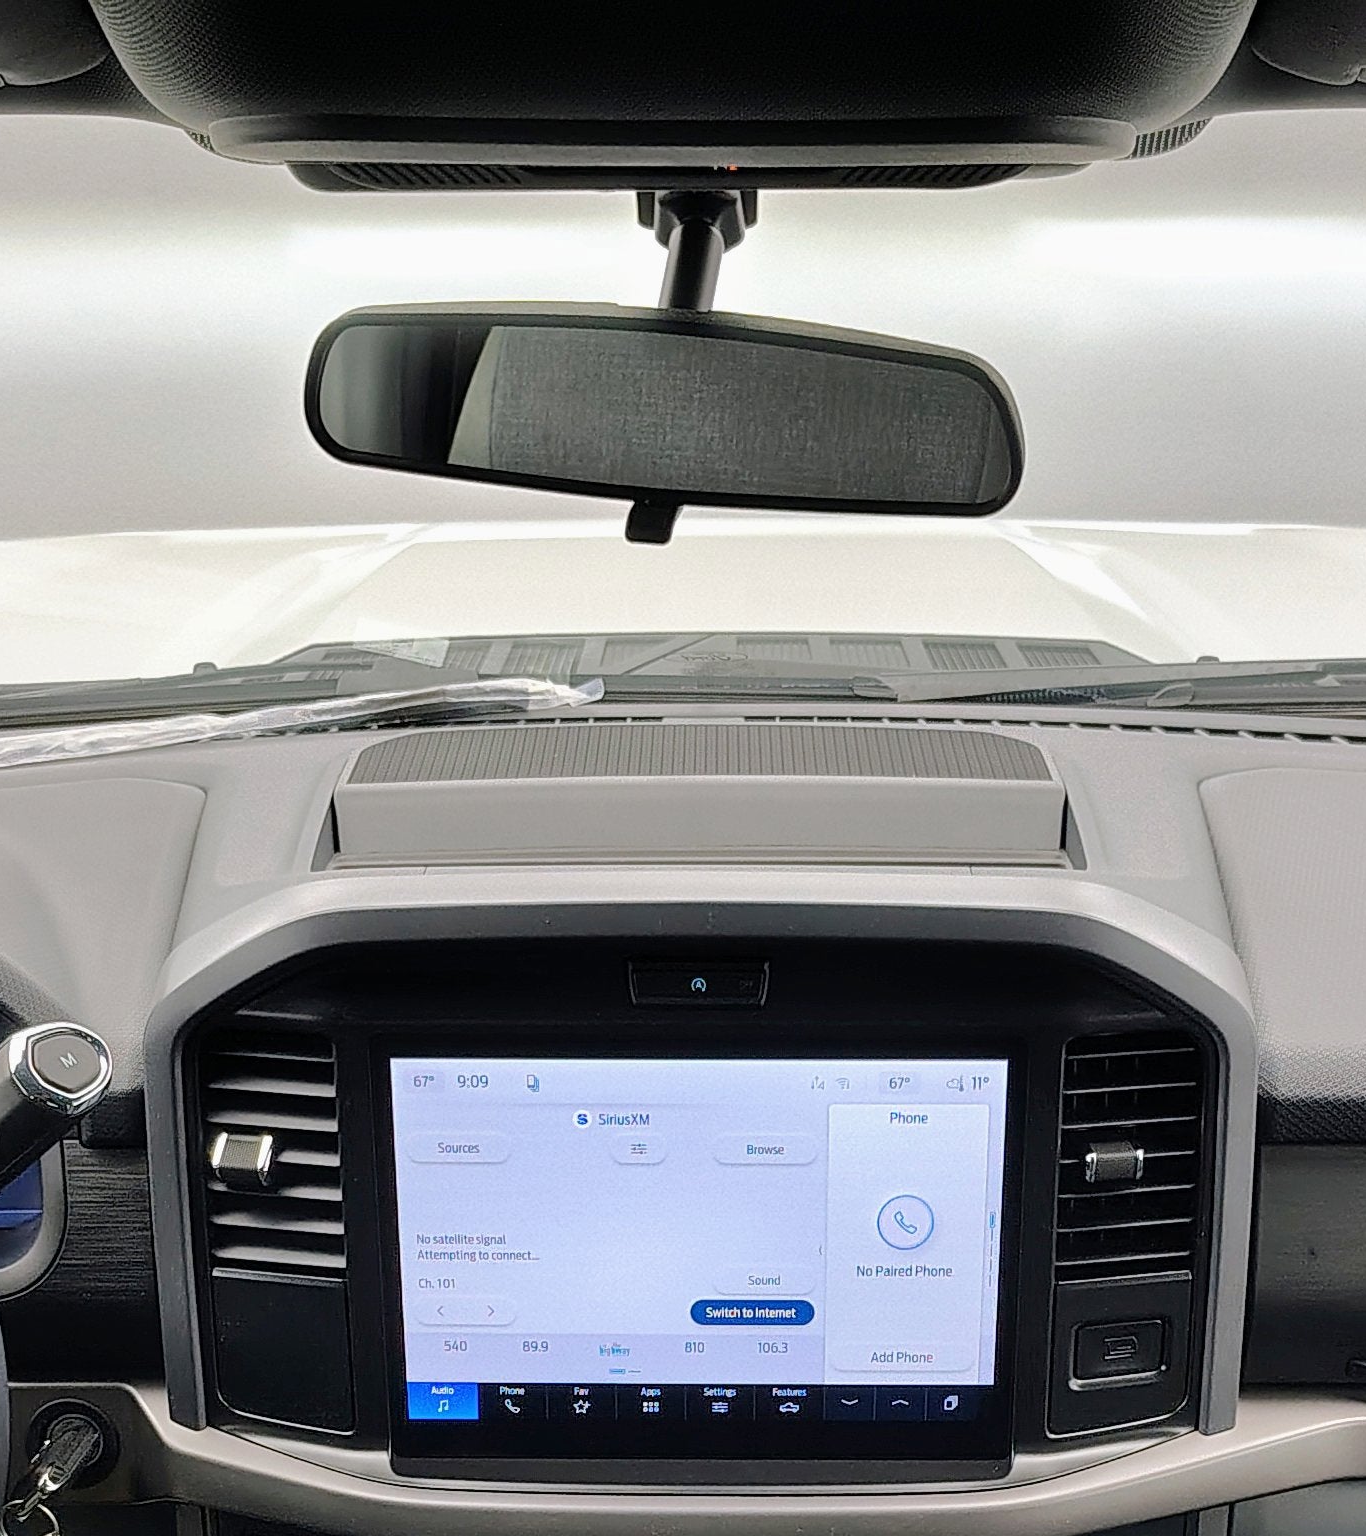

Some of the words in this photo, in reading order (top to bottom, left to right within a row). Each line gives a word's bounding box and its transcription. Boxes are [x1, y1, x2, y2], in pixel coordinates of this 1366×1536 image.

[457, 1074, 488, 1088] 9:09
[598, 1113, 650, 1126] SiriusXM
[889, 1111, 928, 1124] Phone
[438, 1141, 480, 1154] Sources
[746, 1144, 784, 1155] Browse
[416, 1234, 431, 1245] No
[433, 1234, 474, 1245] satellite
[476, 1234, 507, 1247] signal
[417, 1250, 477, 1262] Attempting
[478, 1251, 489, 1261] to
[856, 1266, 873, 1277] No
[875, 1265, 913, 1277] Paired
[915, 1265, 953, 1277] Phone
[418, 1278, 434, 1289] Ch.
[437, 1278, 456, 1289] 101
[748, 1275, 781, 1286] Sound
[705, 1307, 741, 1318] Switch
[742, 1307, 753, 1318] to
[755, 1307, 796, 1318] Internet
[443, 1340, 468, 1352] 540
[522, 1341, 549, 1352] 89.9
[685, 1341, 705, 1353] 810
[757, 1342, 788, 1353] 106.3
[871, 1351, 893, 1363] Add
[896, 1351, 933, 1363] Phone
[431, 1386, 455, 1395] Audio
[499, 1386, 525, 1396] Phone
[574, 1386, 589, 1396] Fav
[641, 1387, 661, 1397] Apps
[703, 1386, 737, 1398] Settings
[772, 1387, 807, 1397] Features
